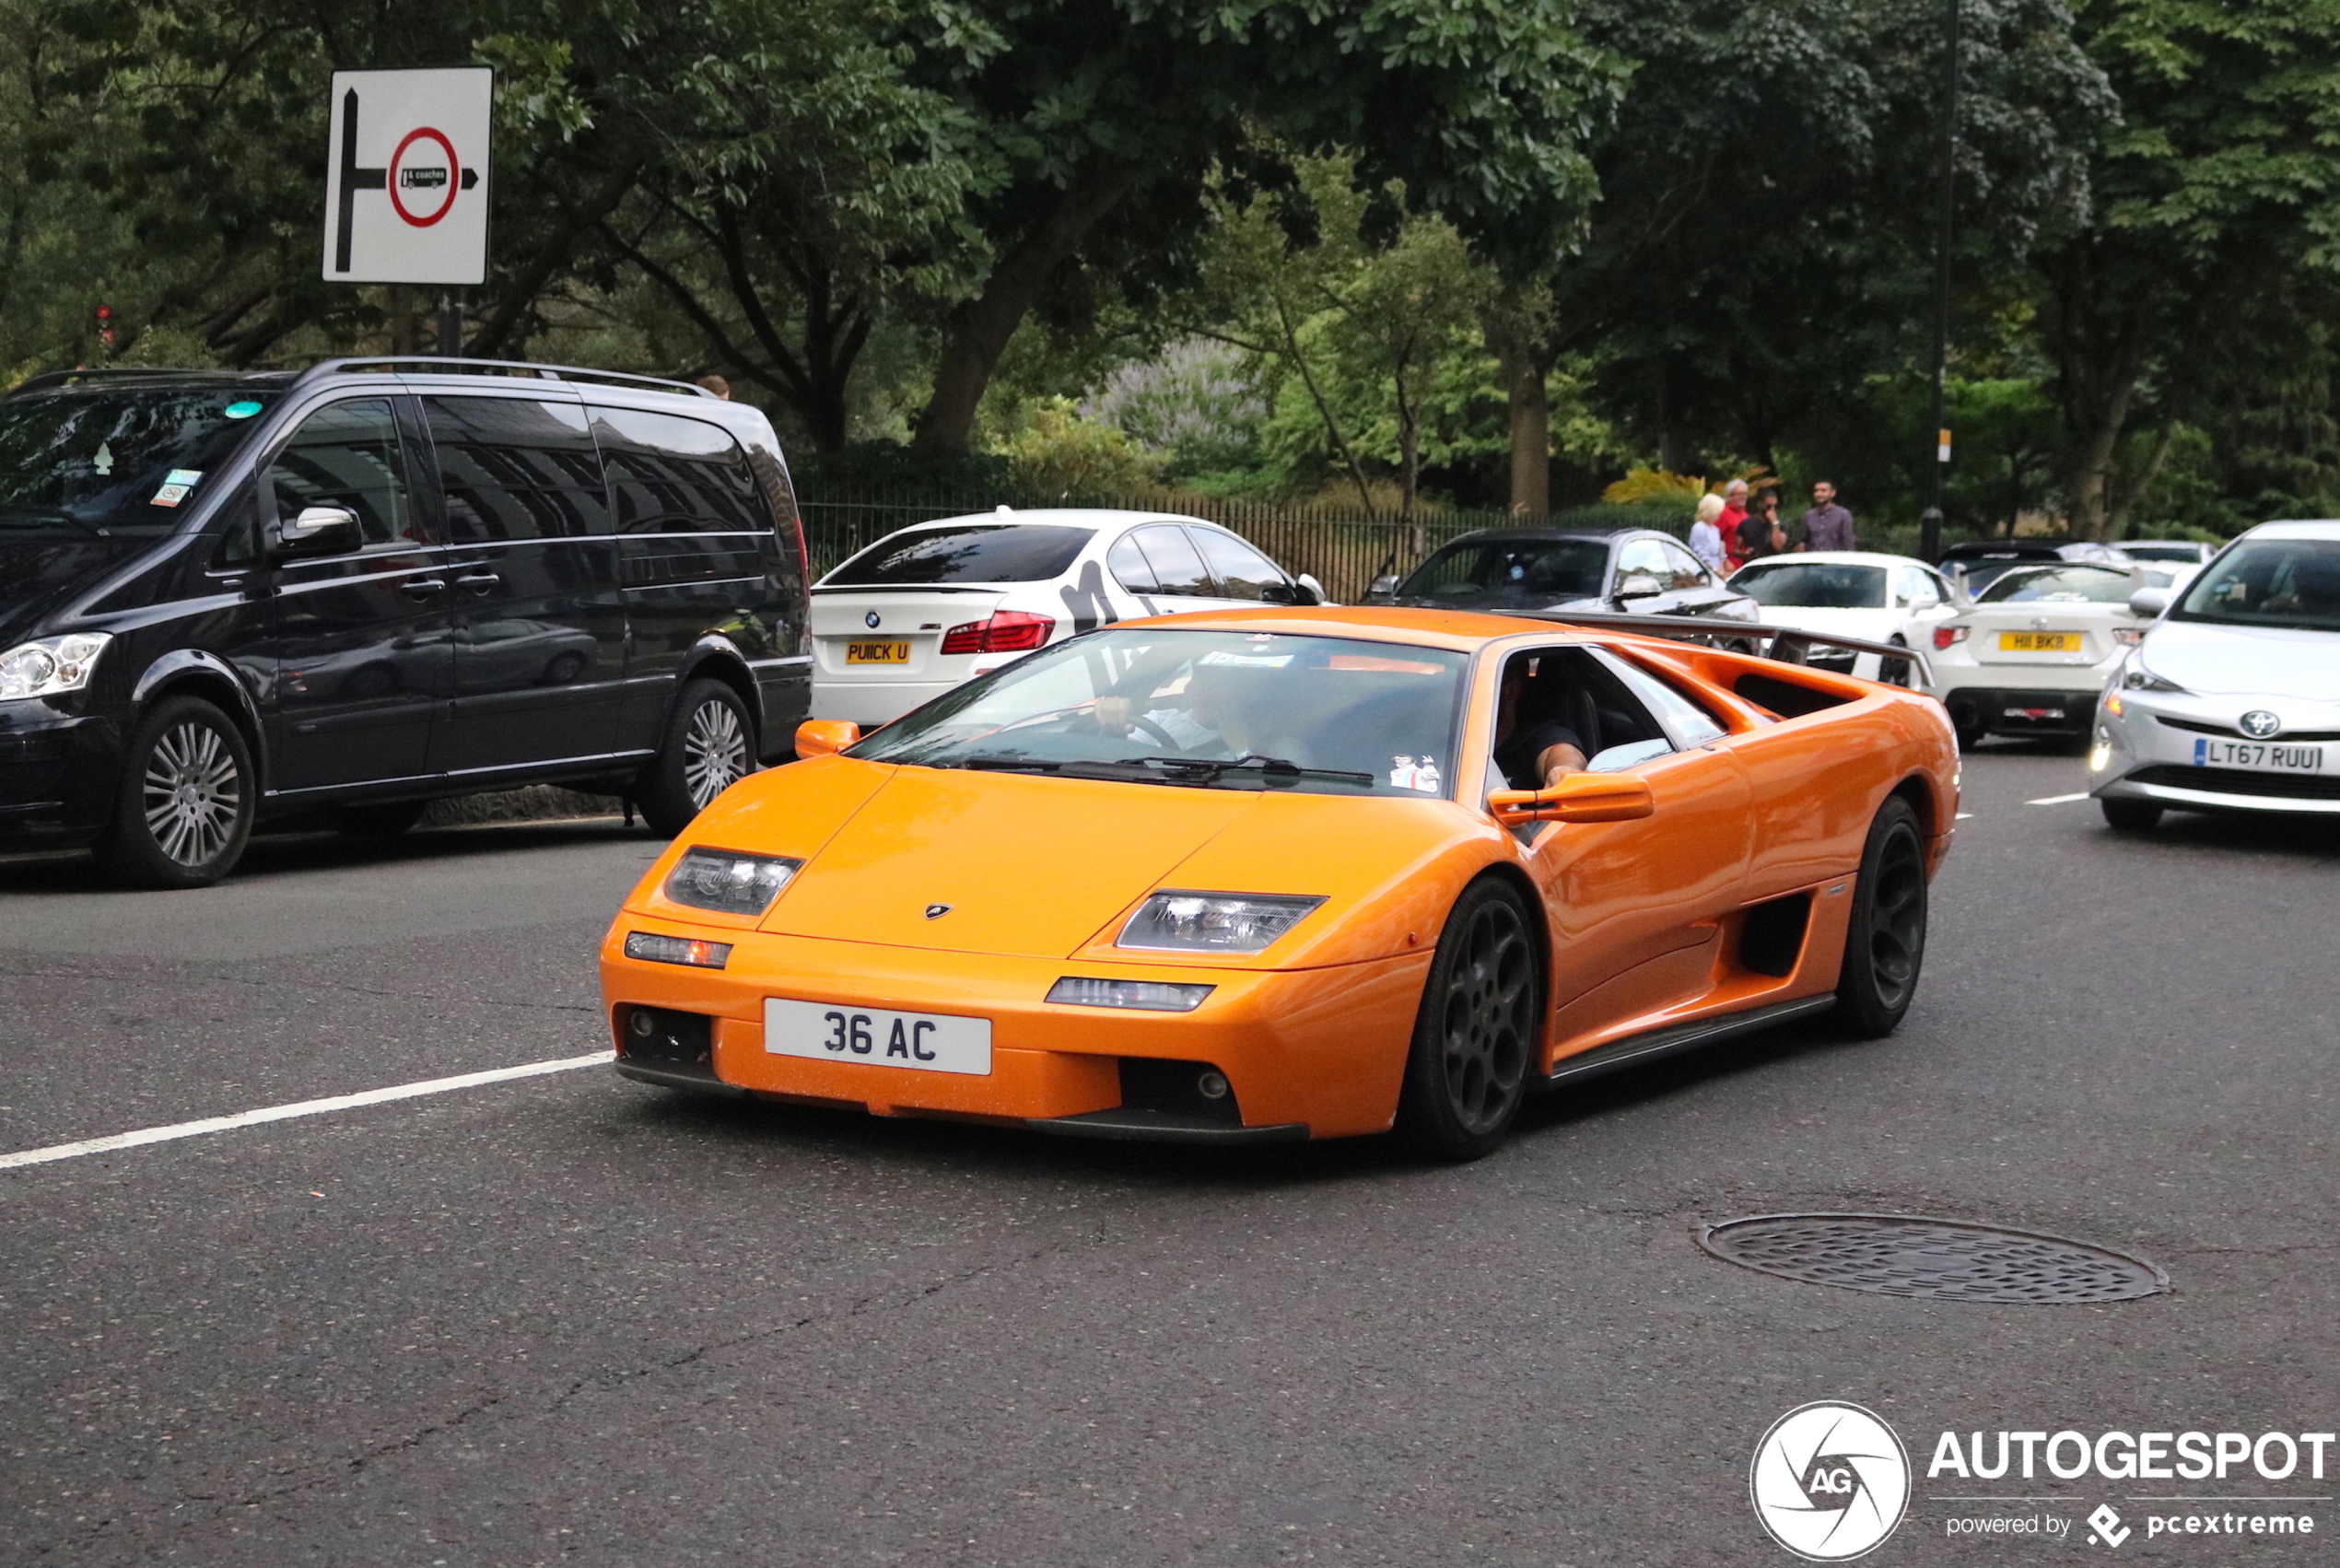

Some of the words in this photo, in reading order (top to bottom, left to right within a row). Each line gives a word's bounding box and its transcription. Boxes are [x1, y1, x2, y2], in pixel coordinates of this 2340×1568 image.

[415, 170, 445, 179] coaches
[897, 644, 907, 660] U
[2209, 743, 2264, 765] LT67
[825, 1012, 872, 1054] 36
[886, 1018, 936, 1060] AC
